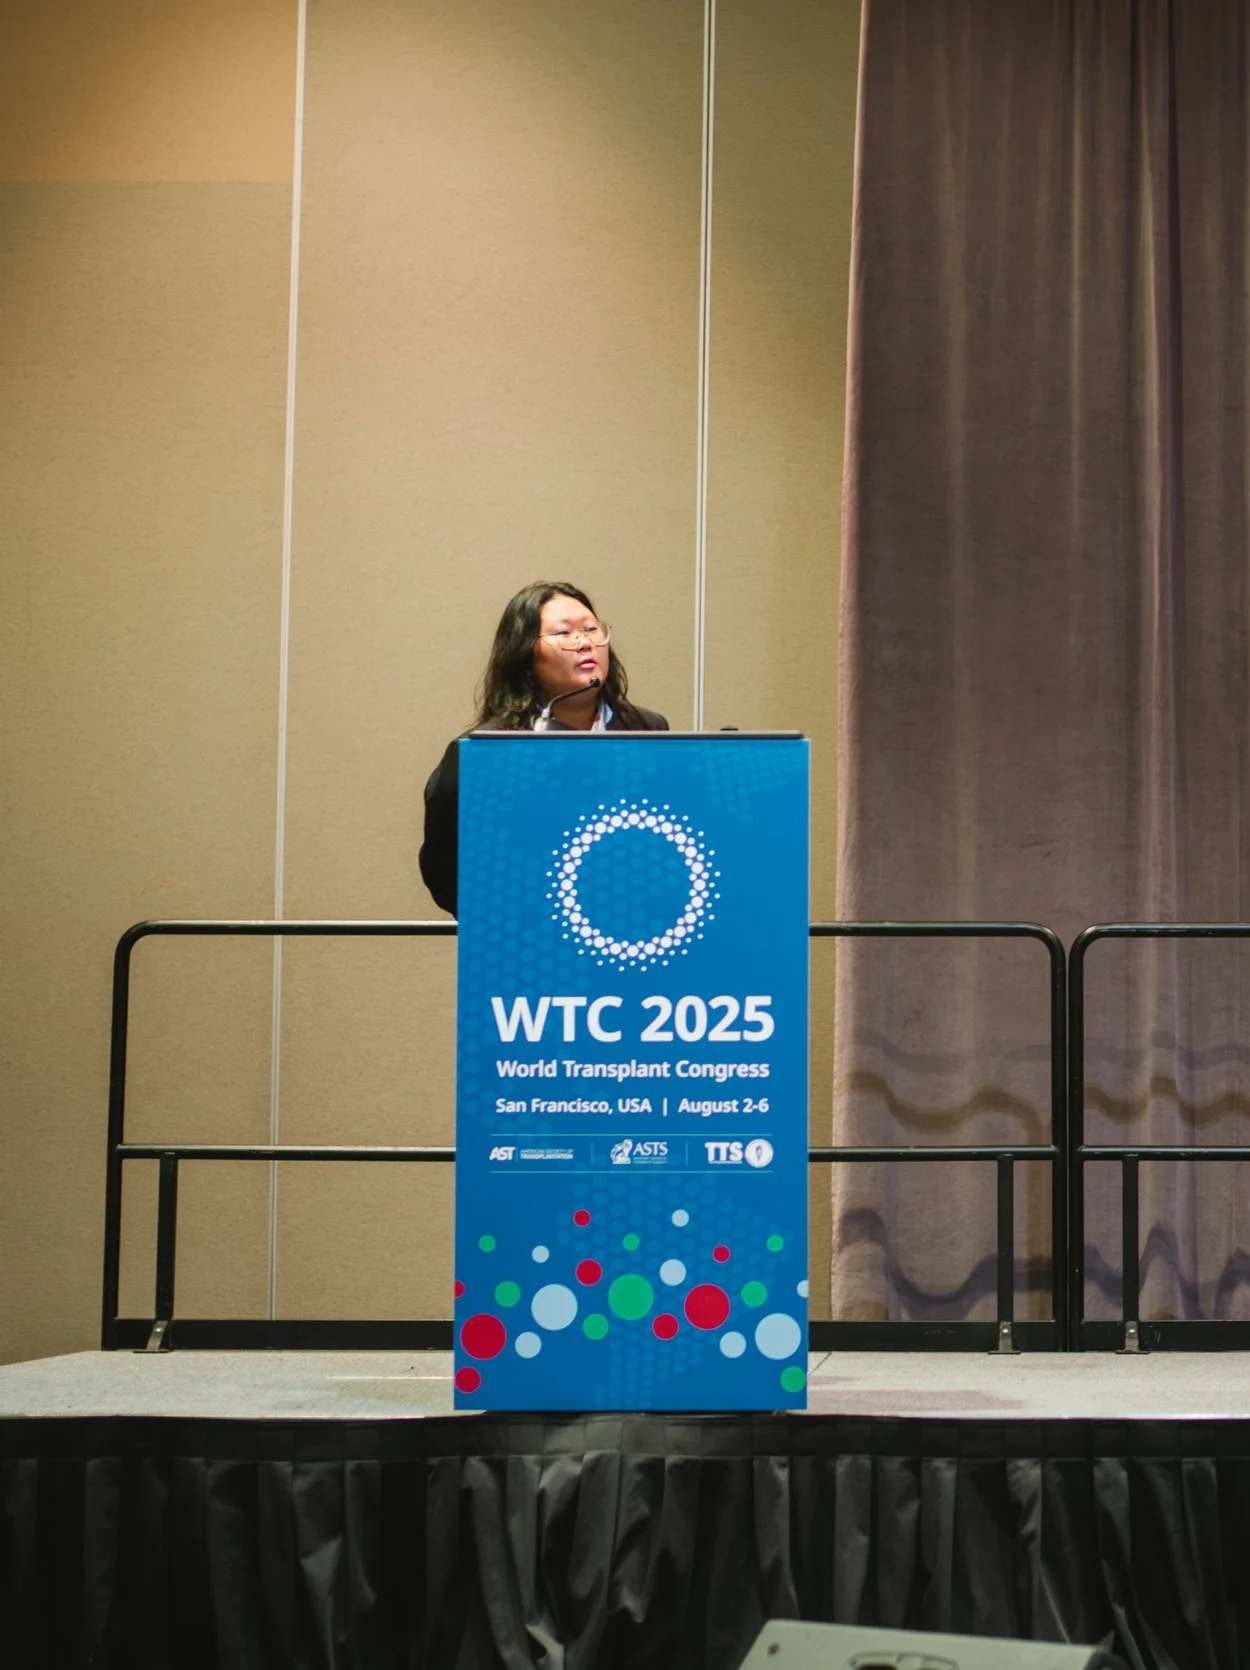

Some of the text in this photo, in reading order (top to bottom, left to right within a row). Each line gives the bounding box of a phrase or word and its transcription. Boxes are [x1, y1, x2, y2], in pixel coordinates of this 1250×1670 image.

[491, 996, 775, 1042] WTC 2025
[496, 1060, 770, 1082] World Transplant Congress
[496, 1098, 527, 1113] San
[531, 1098, 613, 1115] Francisco,
[617, 1098, 652, 1113] USA
[678, 1098, 739, 1117] August
[742, 1098, 770, 1113] 2-6
[489, 1146, 516, 1161] AST
[633, 1141, 669, 1157] ASTS
[704, 1141, 744, 1162] TTS
